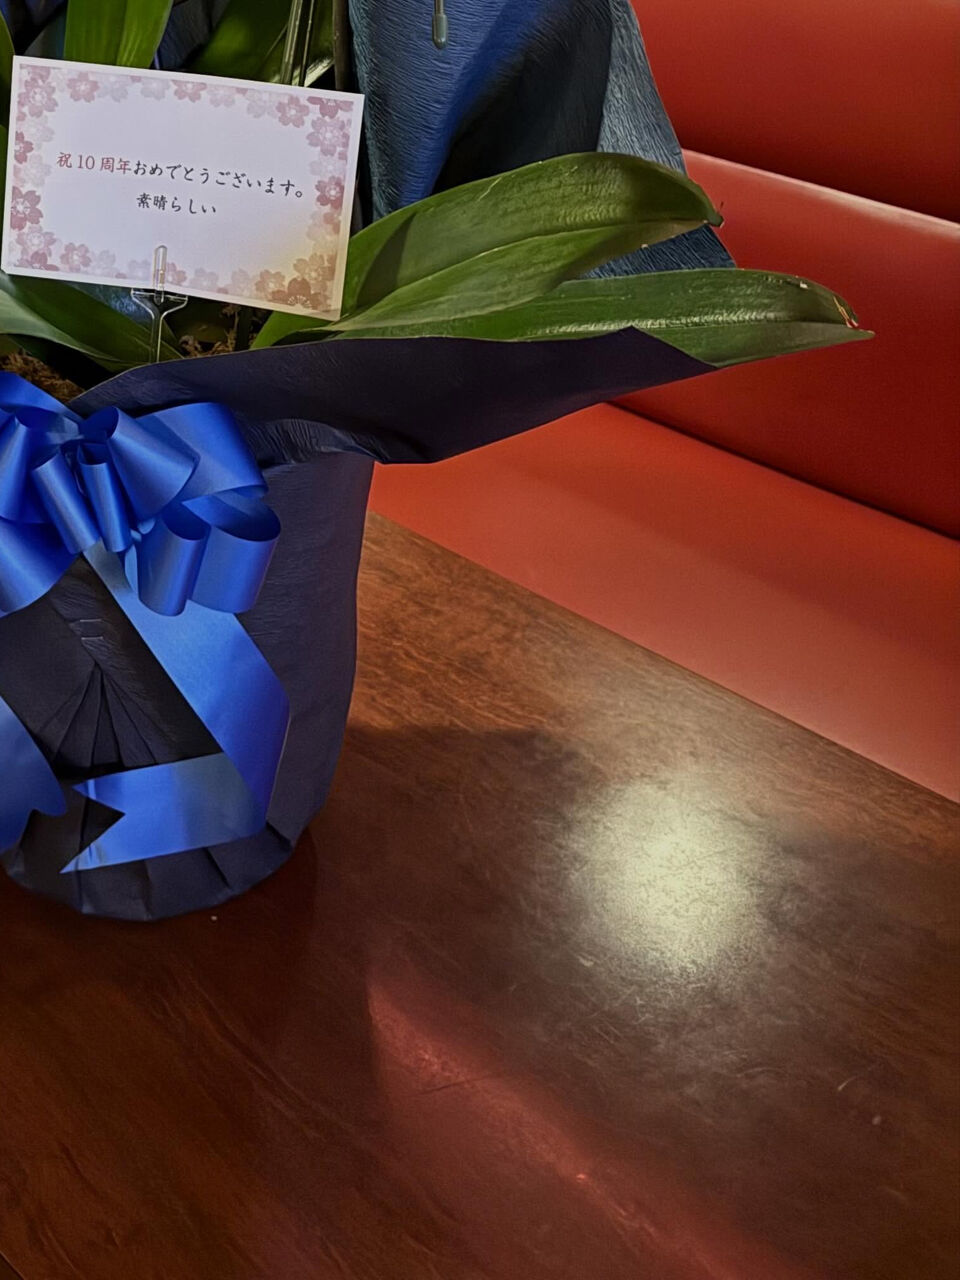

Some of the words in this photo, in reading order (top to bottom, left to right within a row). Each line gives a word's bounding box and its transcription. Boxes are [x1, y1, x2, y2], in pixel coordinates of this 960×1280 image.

[136, 192, 217, 215] 素晴らしい
